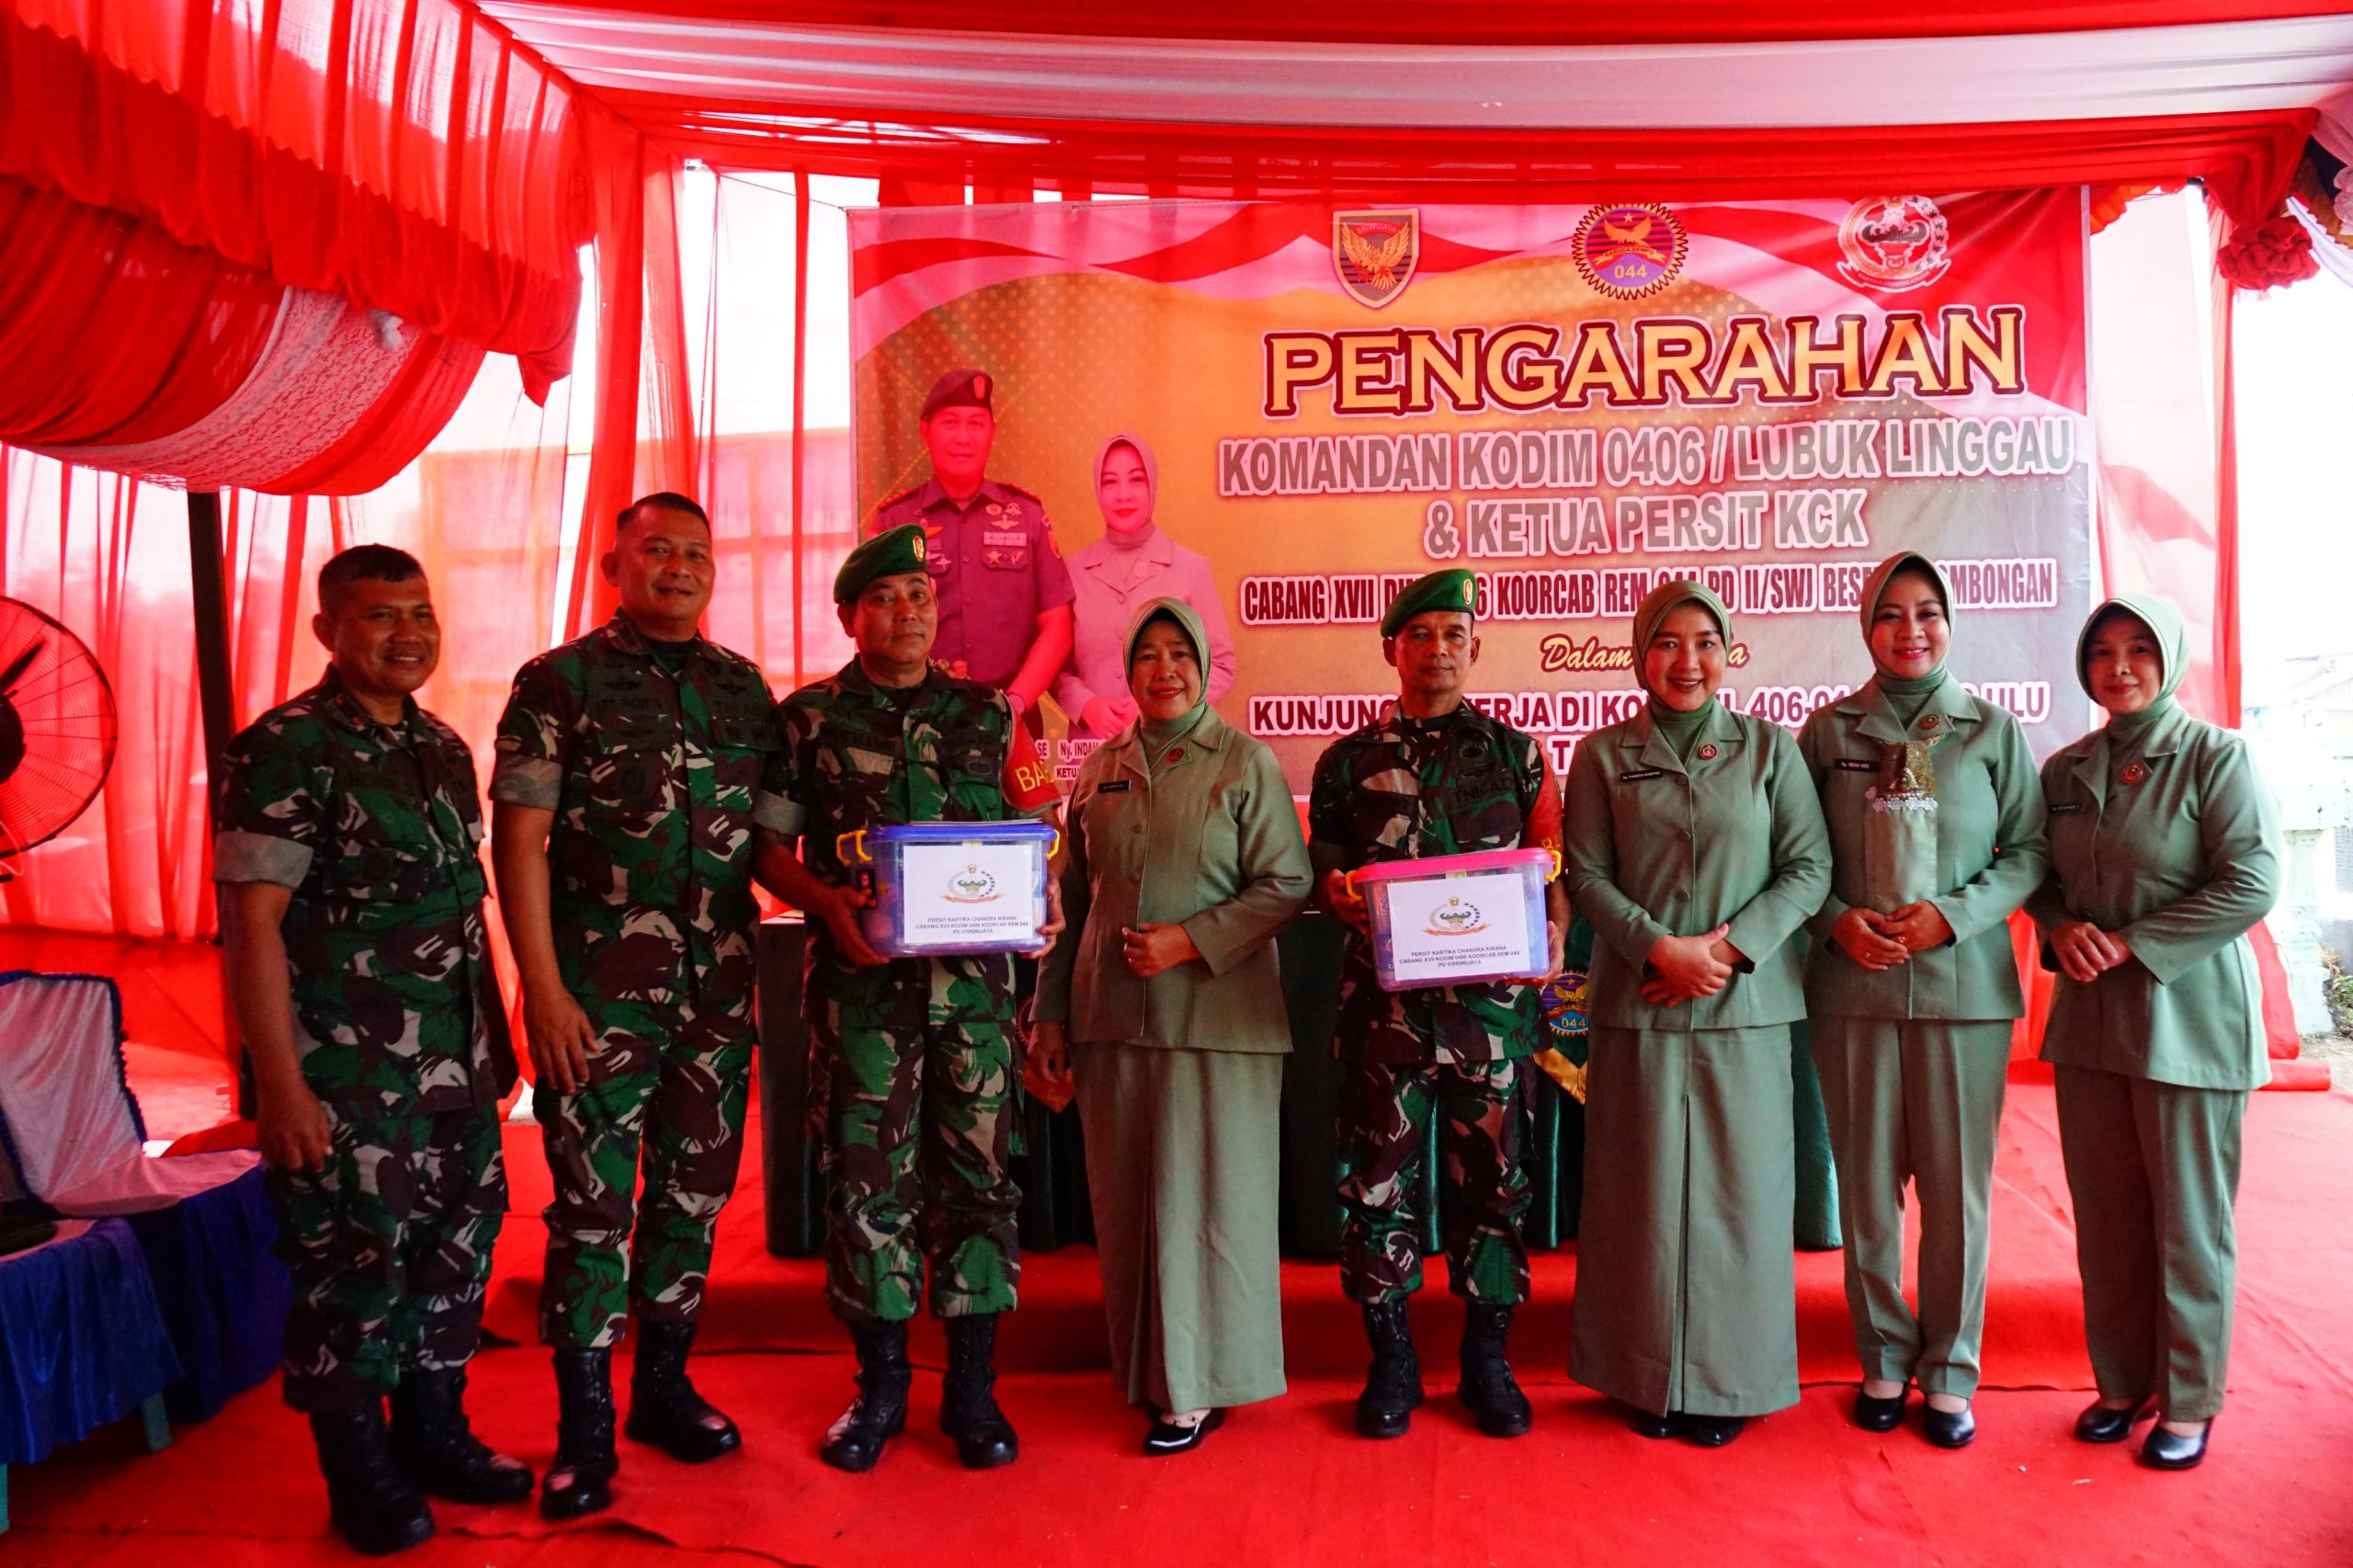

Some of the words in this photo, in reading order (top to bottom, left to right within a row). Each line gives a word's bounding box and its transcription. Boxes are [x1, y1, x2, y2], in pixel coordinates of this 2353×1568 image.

[1614, 265, 1647, 278] 044
[1265, 307, 2027, 416] PENGARAHAN
[1222, 437, 1449, 492] KOMANDAN
[1462, 433, 1593, 485] KODIM
[1607, 429, 1701, 483] 0406
[1737, 422, 1877, 477] LUBUK
[1891, 418, 2073, 472] LINGGAU
[1428, 505, 1456, 554] &
[1471, 501, 1608, 552] KETUA
[1620, 495, 1765, 549] PERSIT
[1779, 493, 1866, 545] KCK
[1245, 580, 1325, 620] CABANG
[1334, 579, 1374, 619] XVII
[1497, 574, 1594, 615] KOORCAB
[1605, 572, 1648, 613] REM
[1745, 566, 1813, 608] II/SWJ
[1541, 634, 1633, 672] Dalam
[1469, 697, 1551, 728] ERJA
[1562, 696, 1589, 726] DI
[1061, 742, 1073, 759] Ny.
[1056, 767, 1079, 778] KETU
[1561, 1017, 1586, 1028] 044
